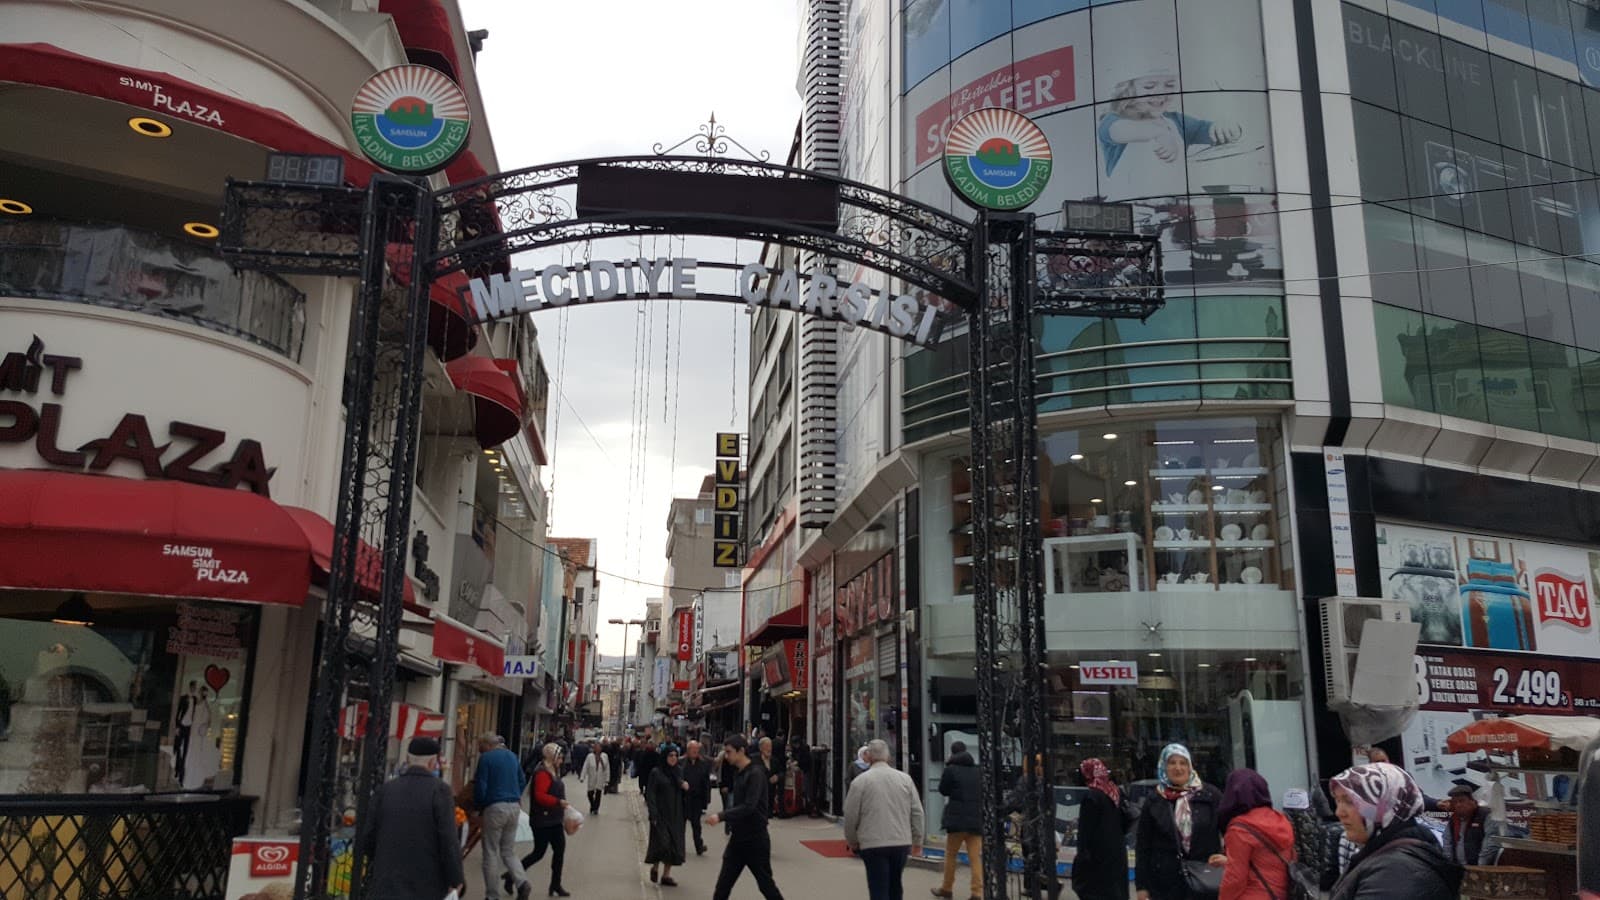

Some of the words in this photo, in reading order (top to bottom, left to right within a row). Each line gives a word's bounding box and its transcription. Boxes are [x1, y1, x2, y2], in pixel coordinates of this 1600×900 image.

[1348, 20, 1481, 86] BLACKLINE
[153, 92, 225, 126] PLAZA
[390, 128, 427, 137] SAMSUN
[983, 168, 1016, 177] SAMSUN
[163, 544, 212, 558] SAMSUN
[197, 569, 249, 584] PLAZA
[1082, 667, 1136, 679] VESTEL
[1493, 667, 1560, 706] 2.499
[256, 863, 287, 871] ALGIDA
